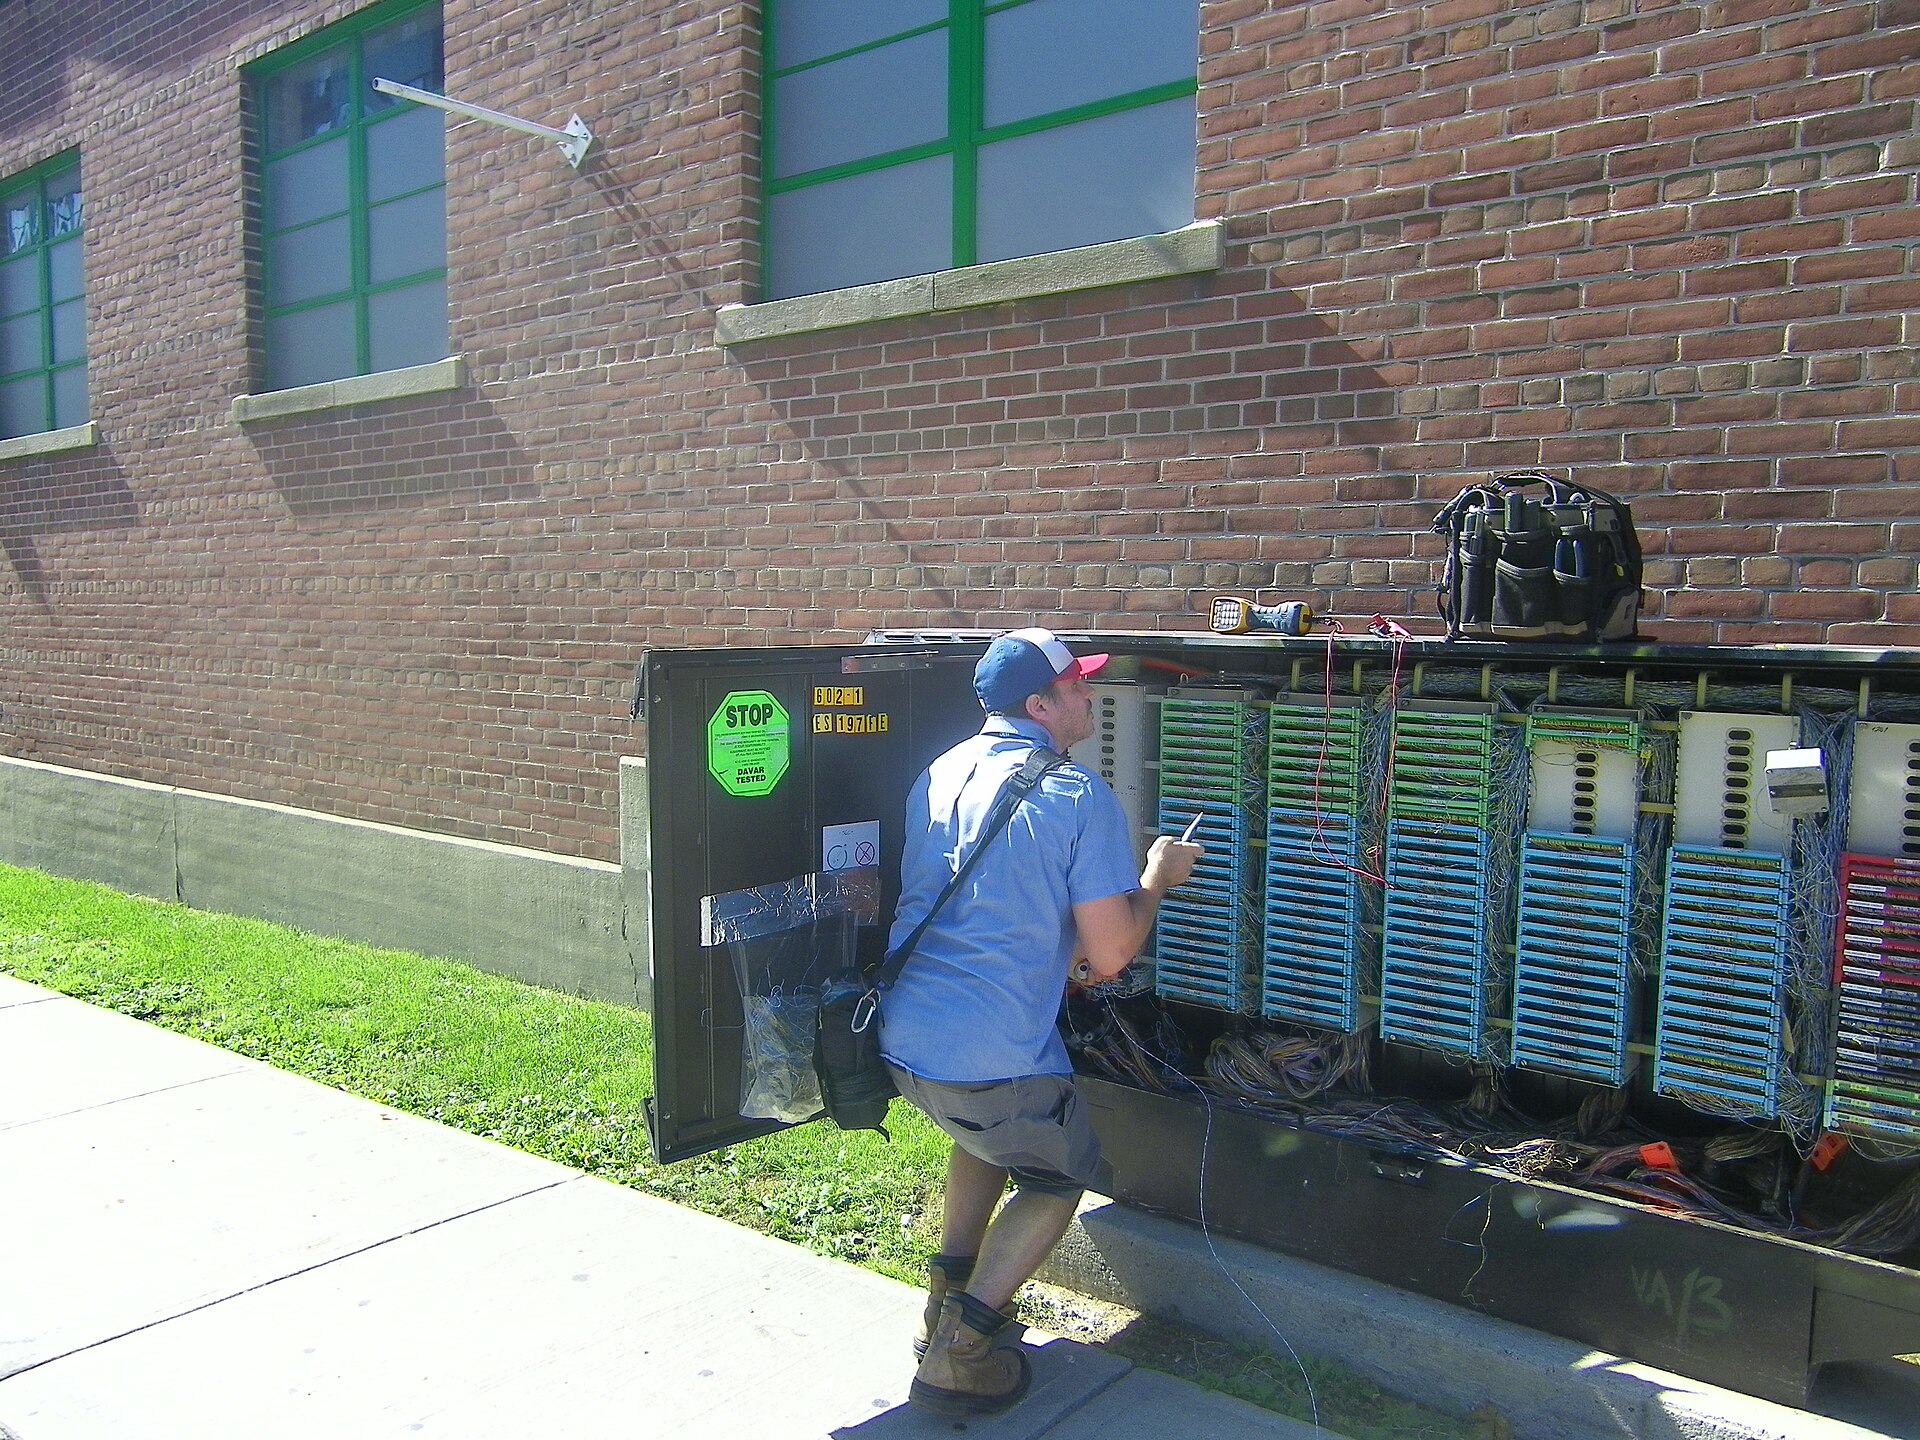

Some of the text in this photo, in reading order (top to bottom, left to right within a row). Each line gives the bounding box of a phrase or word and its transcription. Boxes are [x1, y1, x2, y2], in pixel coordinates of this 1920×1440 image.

[815, 687, 863, 705] 602-1
[726, 703, 774, 728] STOP
[815, 714, 831, 731] ES
[735, 775, 766, 784] TESTED
[737, 766, 765, 776] DAVAR
